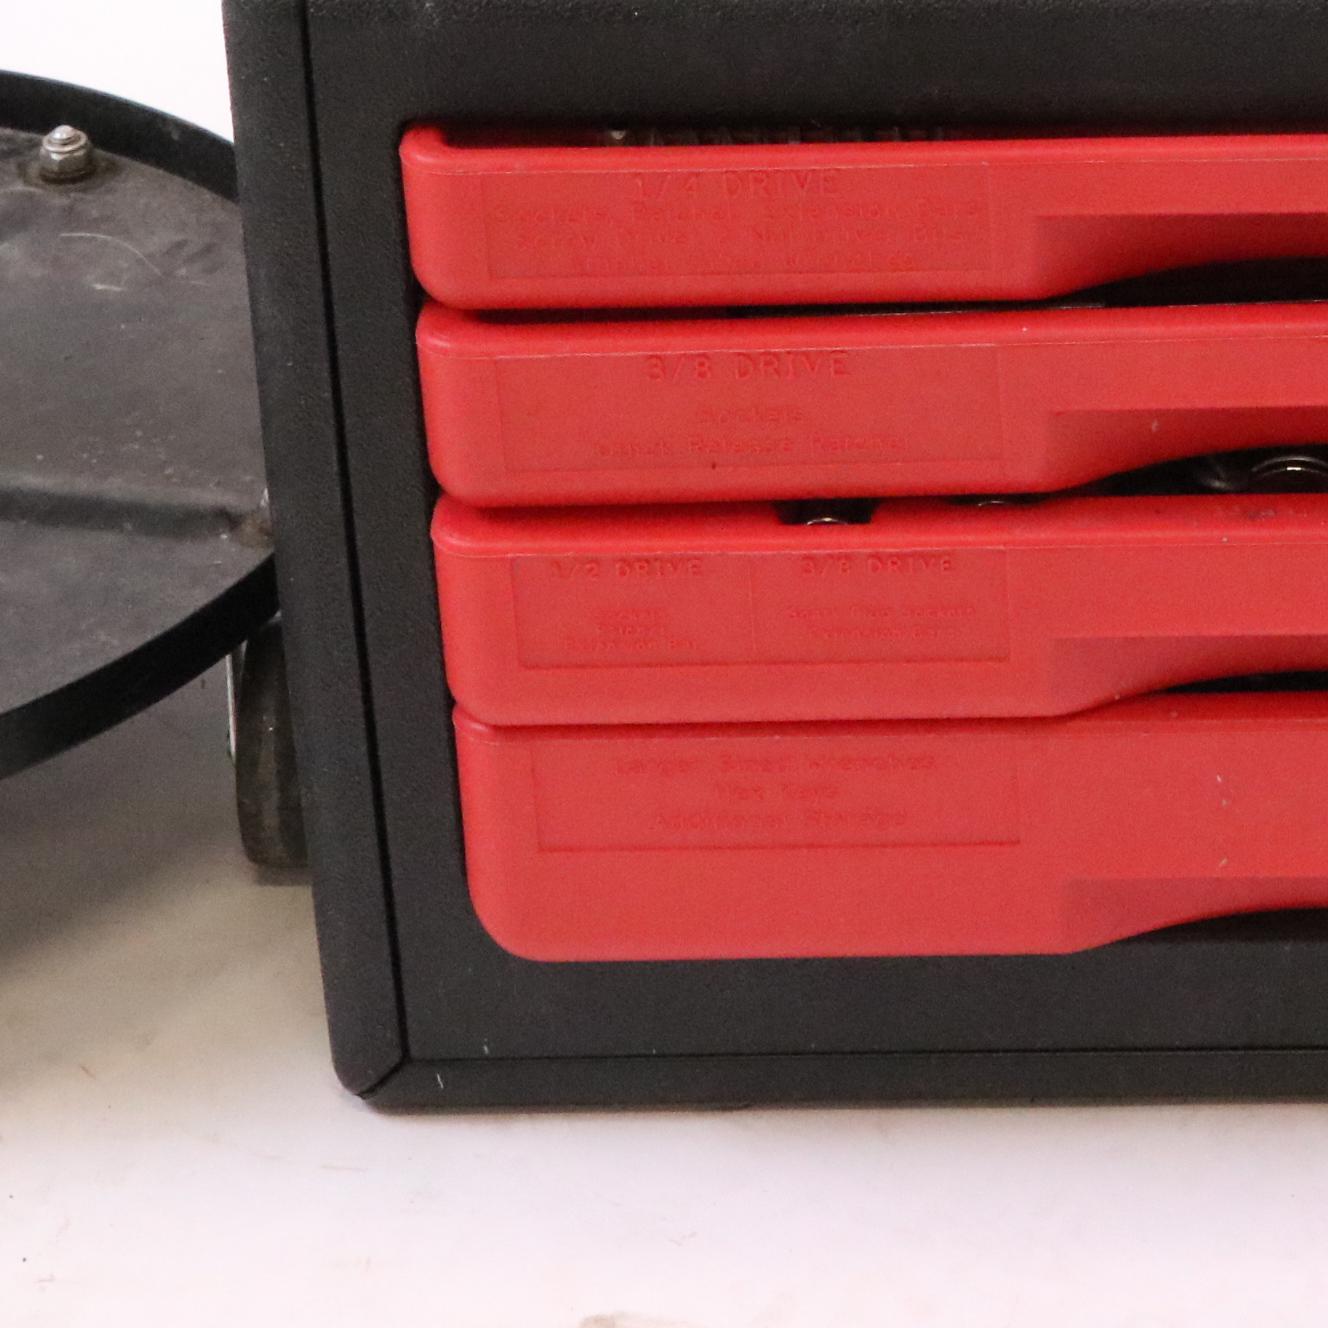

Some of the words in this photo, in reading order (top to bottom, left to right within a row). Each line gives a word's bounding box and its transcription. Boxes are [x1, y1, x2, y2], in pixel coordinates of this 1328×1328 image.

[632, 172, 700, 201] 1/4
[722, 170, 840, 199] DRIVE
[644, 354, 713, 383] 3/8
[733, 351, 851, 381] DRIVE
[614, 556, 704, 580] DRIVE
[801, 555, 853, 578] 3/8
[866, 553, 955, 576] DRIVE
